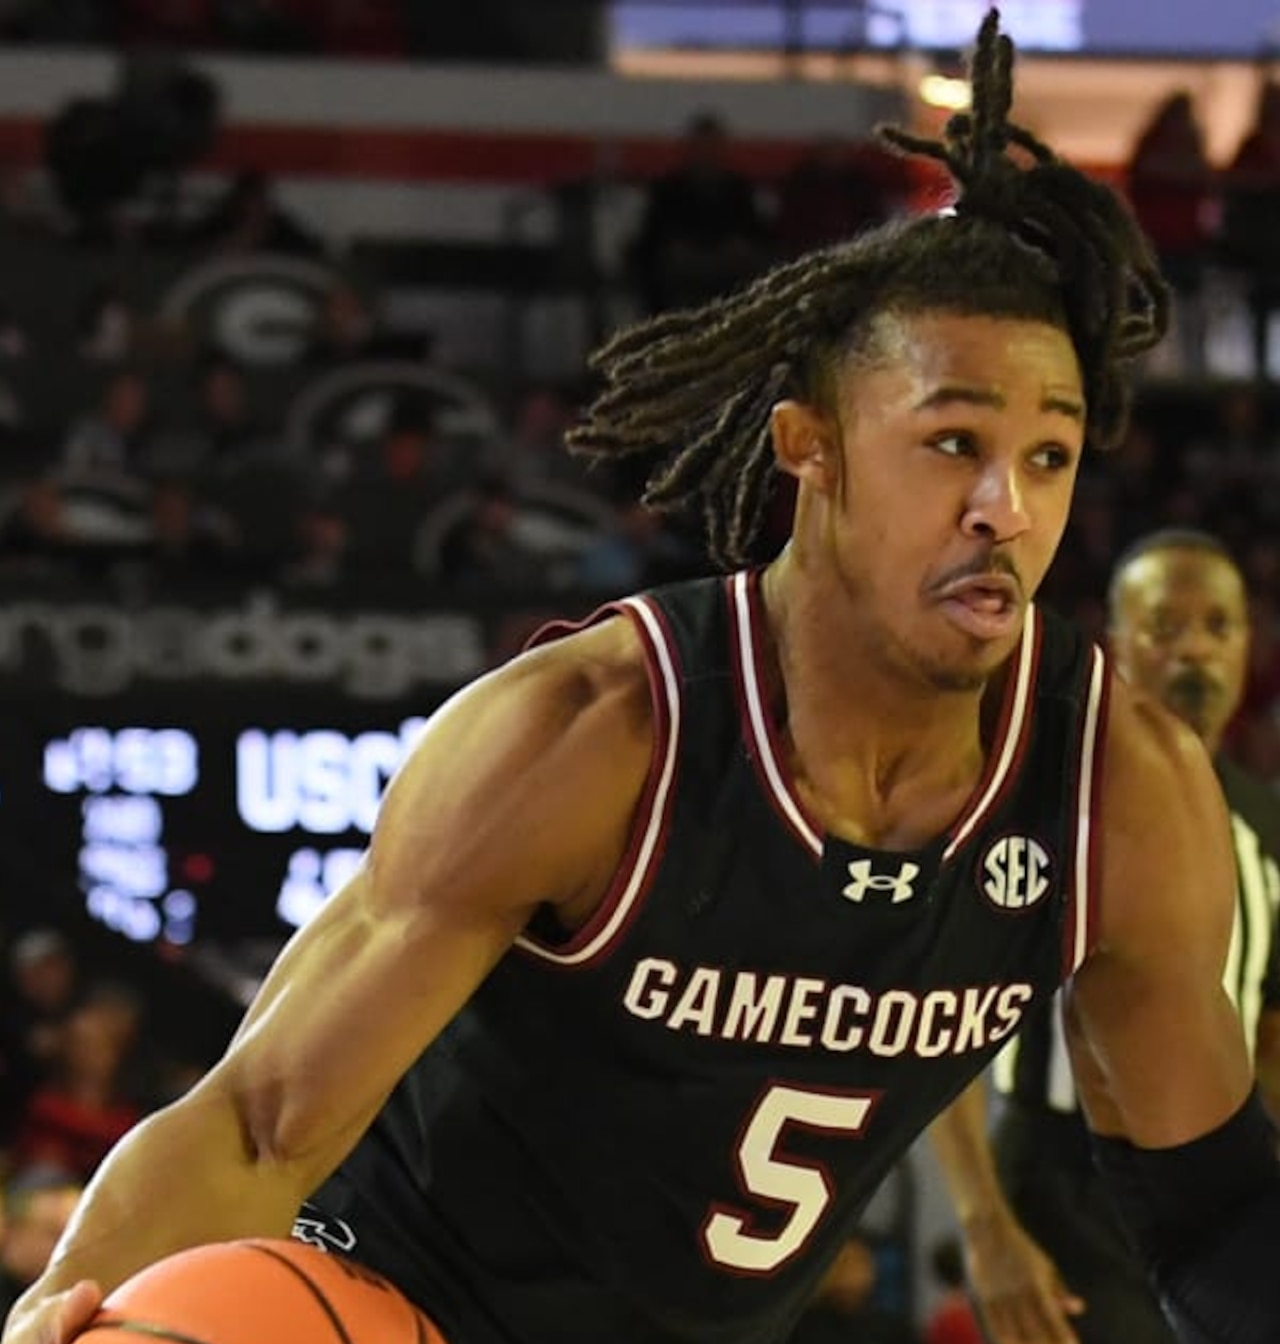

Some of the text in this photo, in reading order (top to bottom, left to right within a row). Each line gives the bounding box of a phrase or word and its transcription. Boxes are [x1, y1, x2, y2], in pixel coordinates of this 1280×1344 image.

[982, 835, 1051, 909] SEC
[622, 955, 1033, 1060] GAMECOCKS
[703, 1084, 874, 1272] 5
